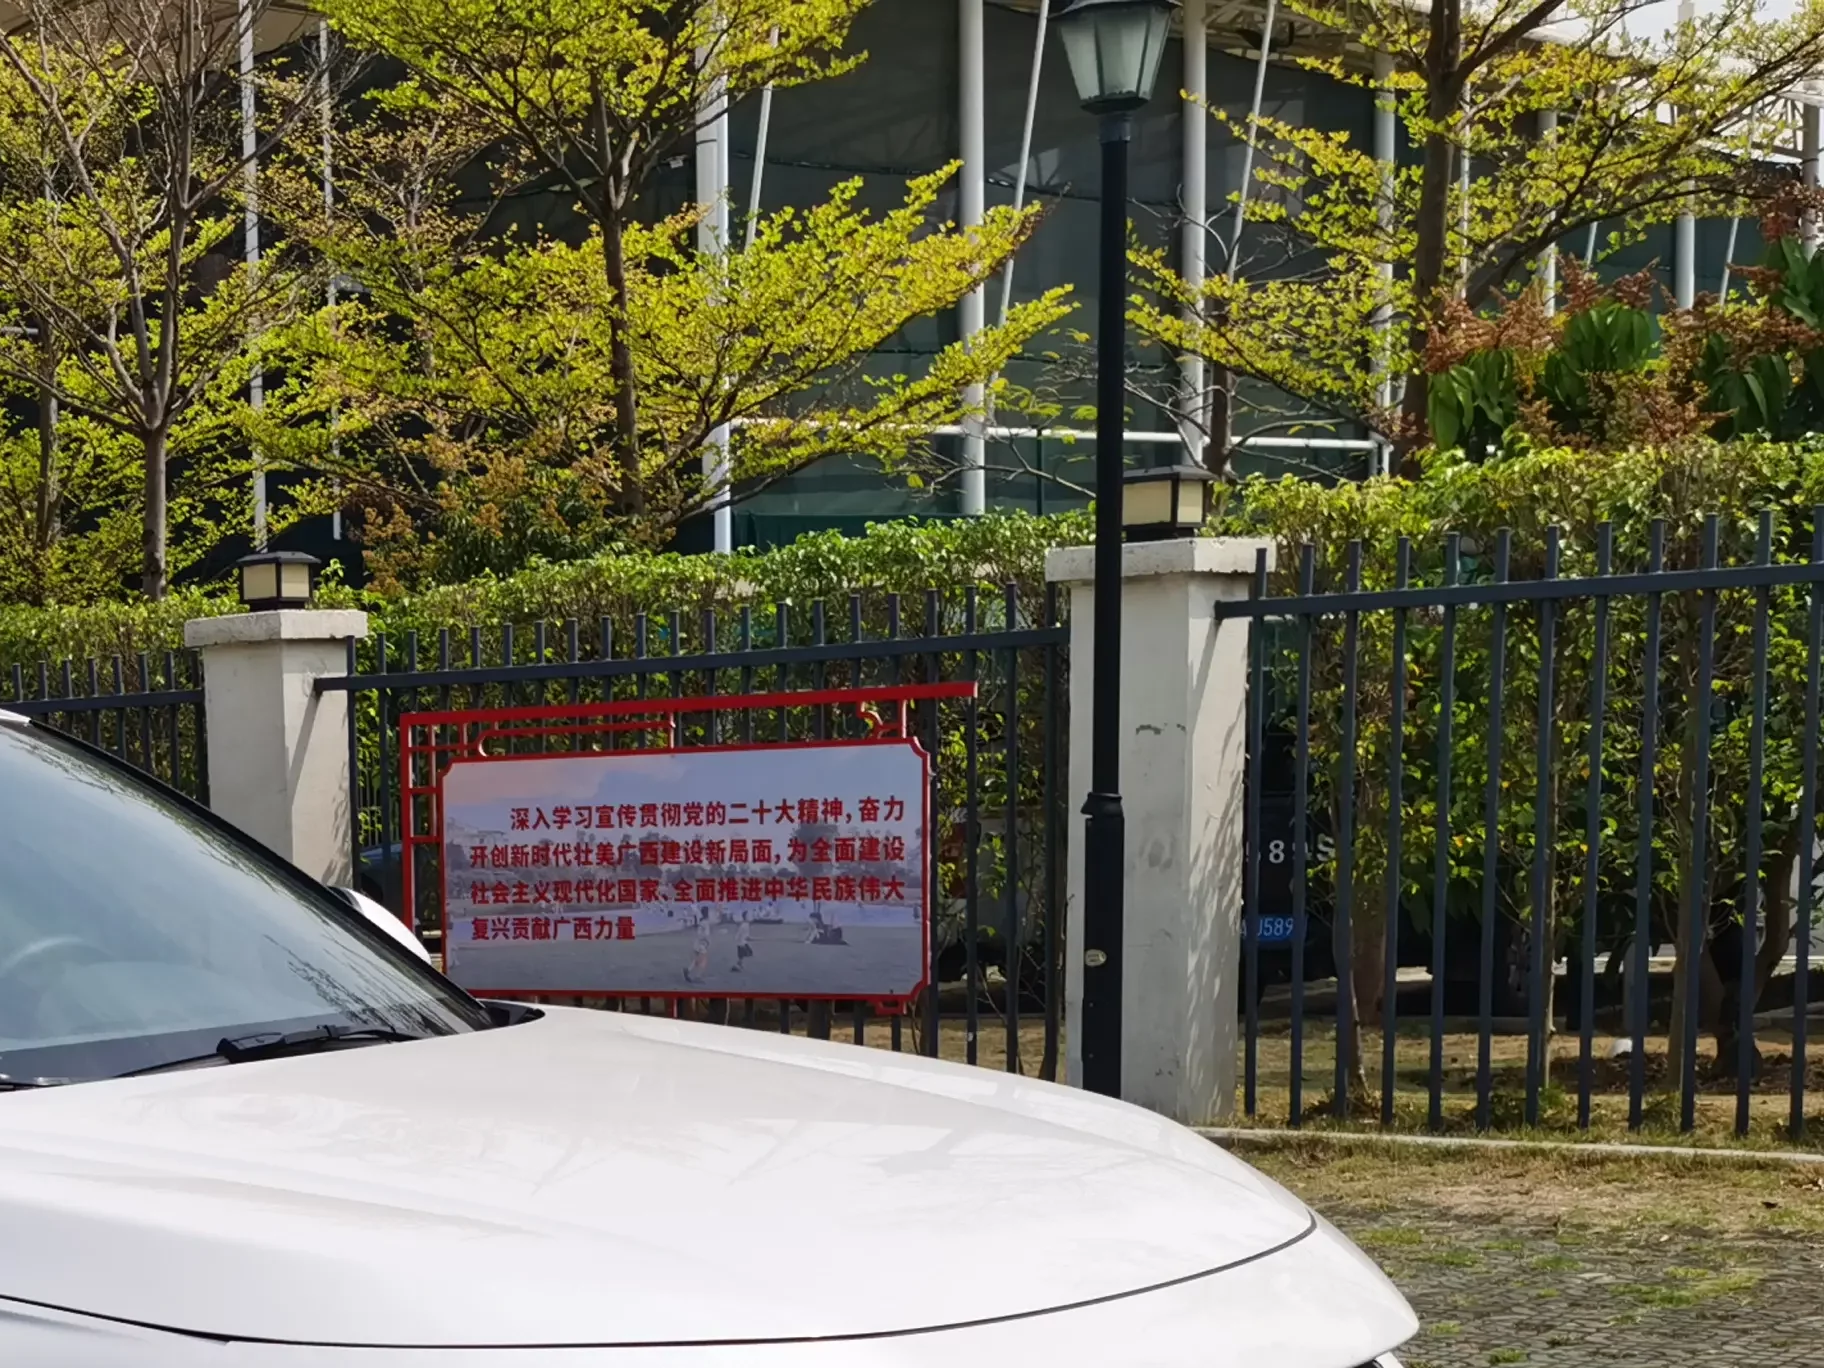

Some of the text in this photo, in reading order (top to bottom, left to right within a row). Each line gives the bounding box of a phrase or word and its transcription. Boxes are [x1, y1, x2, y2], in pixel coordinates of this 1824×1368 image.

[471, 916, 636, 941] 复兴贡献广西力量
